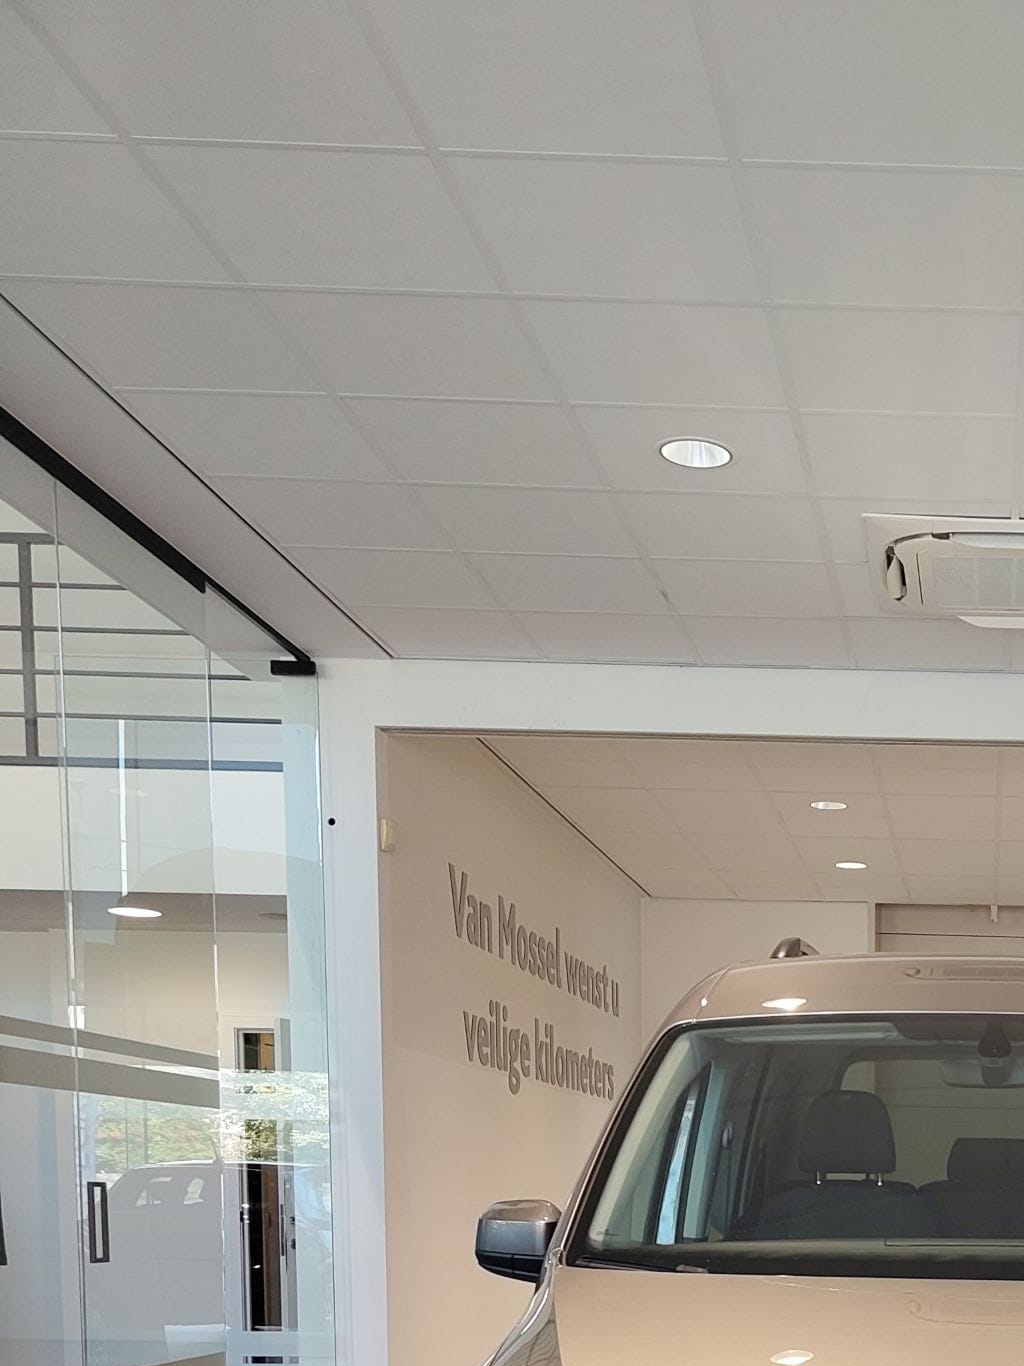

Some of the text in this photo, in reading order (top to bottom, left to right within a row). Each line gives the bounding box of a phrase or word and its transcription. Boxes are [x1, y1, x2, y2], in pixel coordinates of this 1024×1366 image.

[448, 862, 619, 1018] Van Mossel wenst u
[463, 1000, 614, 1101] veilige kilometers
